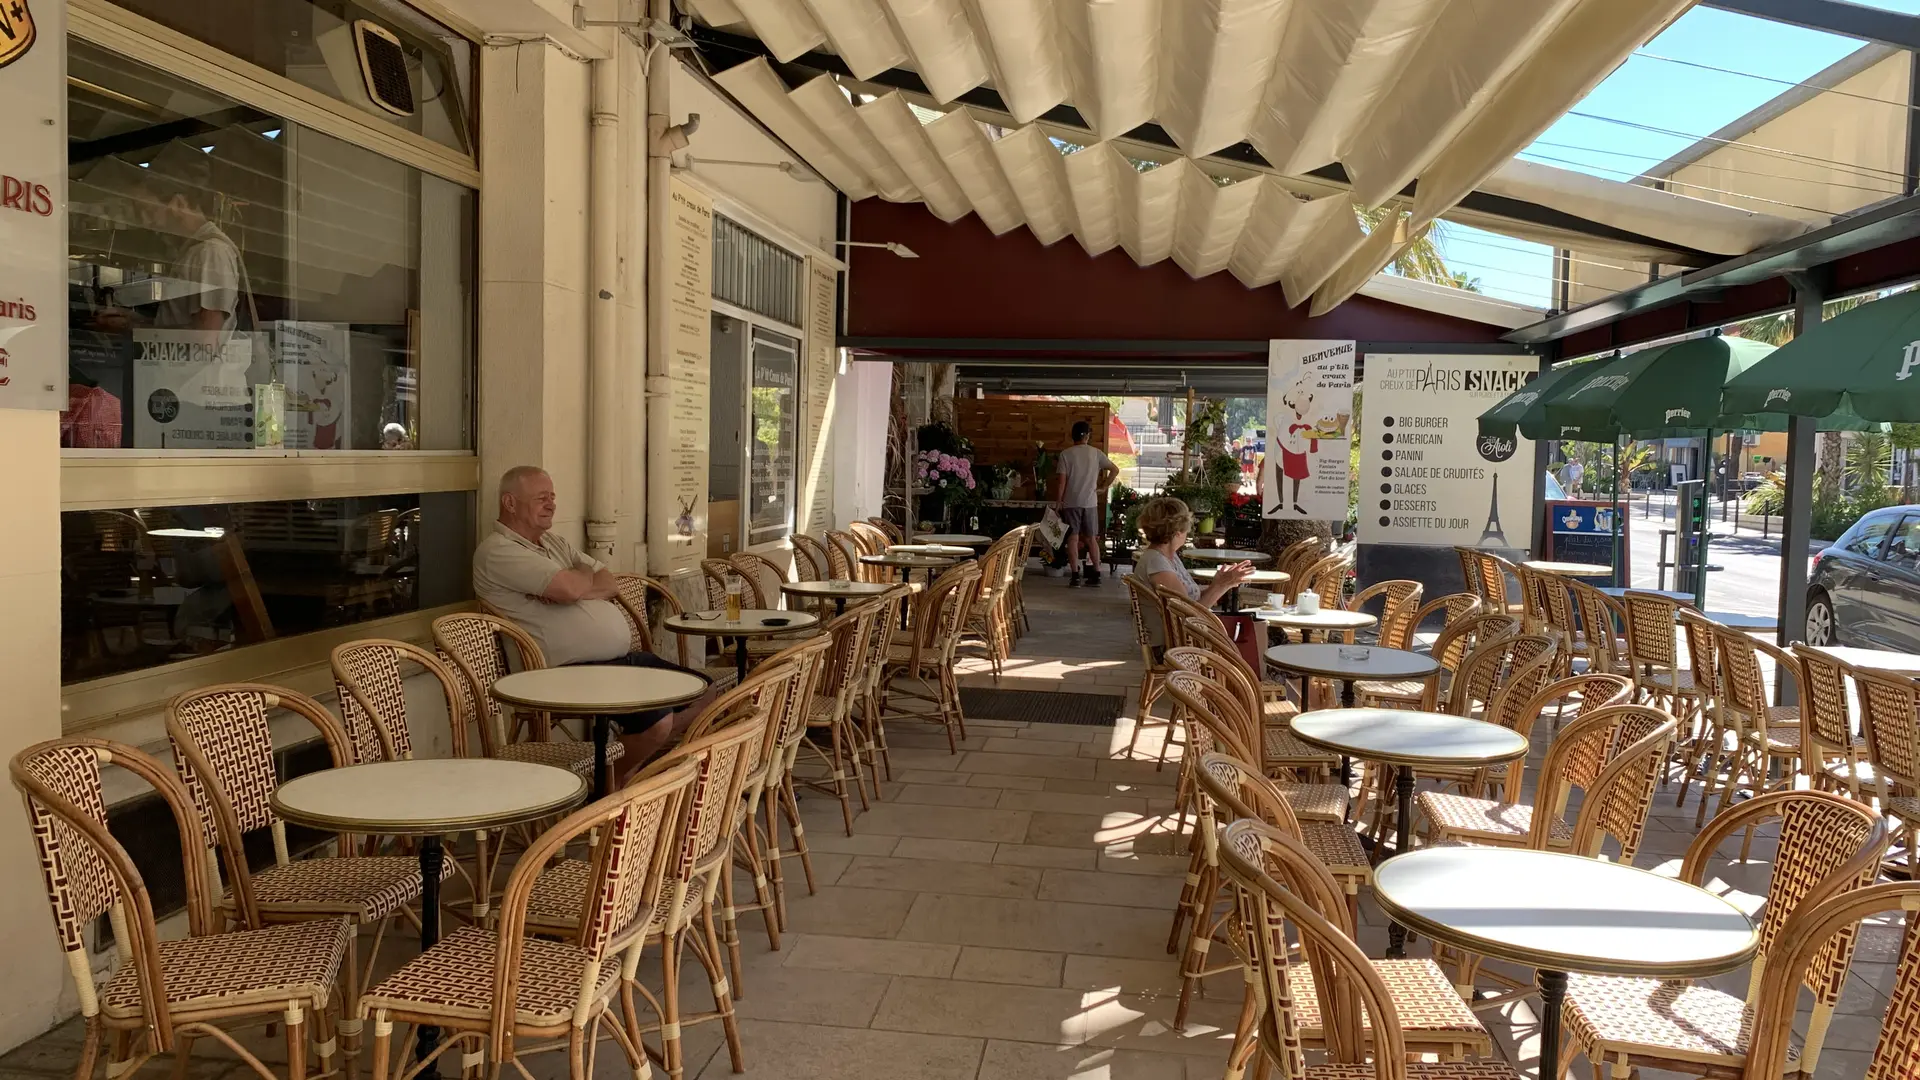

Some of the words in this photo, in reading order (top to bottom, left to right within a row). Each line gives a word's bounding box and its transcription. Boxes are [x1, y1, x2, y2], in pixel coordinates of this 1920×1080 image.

[1302, 343, 1353, 365] BIENVENUE
[1387, 369, 1396, 379] AU
[1415, 360, 1461, 395] PARIS
[1380, 380, 1403, 390] CREUX
[1405, 380, 1416, 390] DE
[1468, 370, 1530, 391] SNACK
[1399, 416, 1413, 428] BIG
[1414, 416, 1449, 428] BURGER
[1396, 433, 1443, 445] AMERICAIN
[1395, 450, 1423, 461] PANINI
[1395, 466, 1429, 478] SALADE
[1430, 467, 1441, 478] DE
[1443, 467, 1485, 480] CRUDITÉS
[1394, 483, 1427, 495] GLACES
[1393, 499, 1437, 512] DESSERTS
[1392, 516, 1433, 528] ASSIETTE
[1434, 518, 1446, 529] DU
[1448, 518, 1469, 529] JOUR
